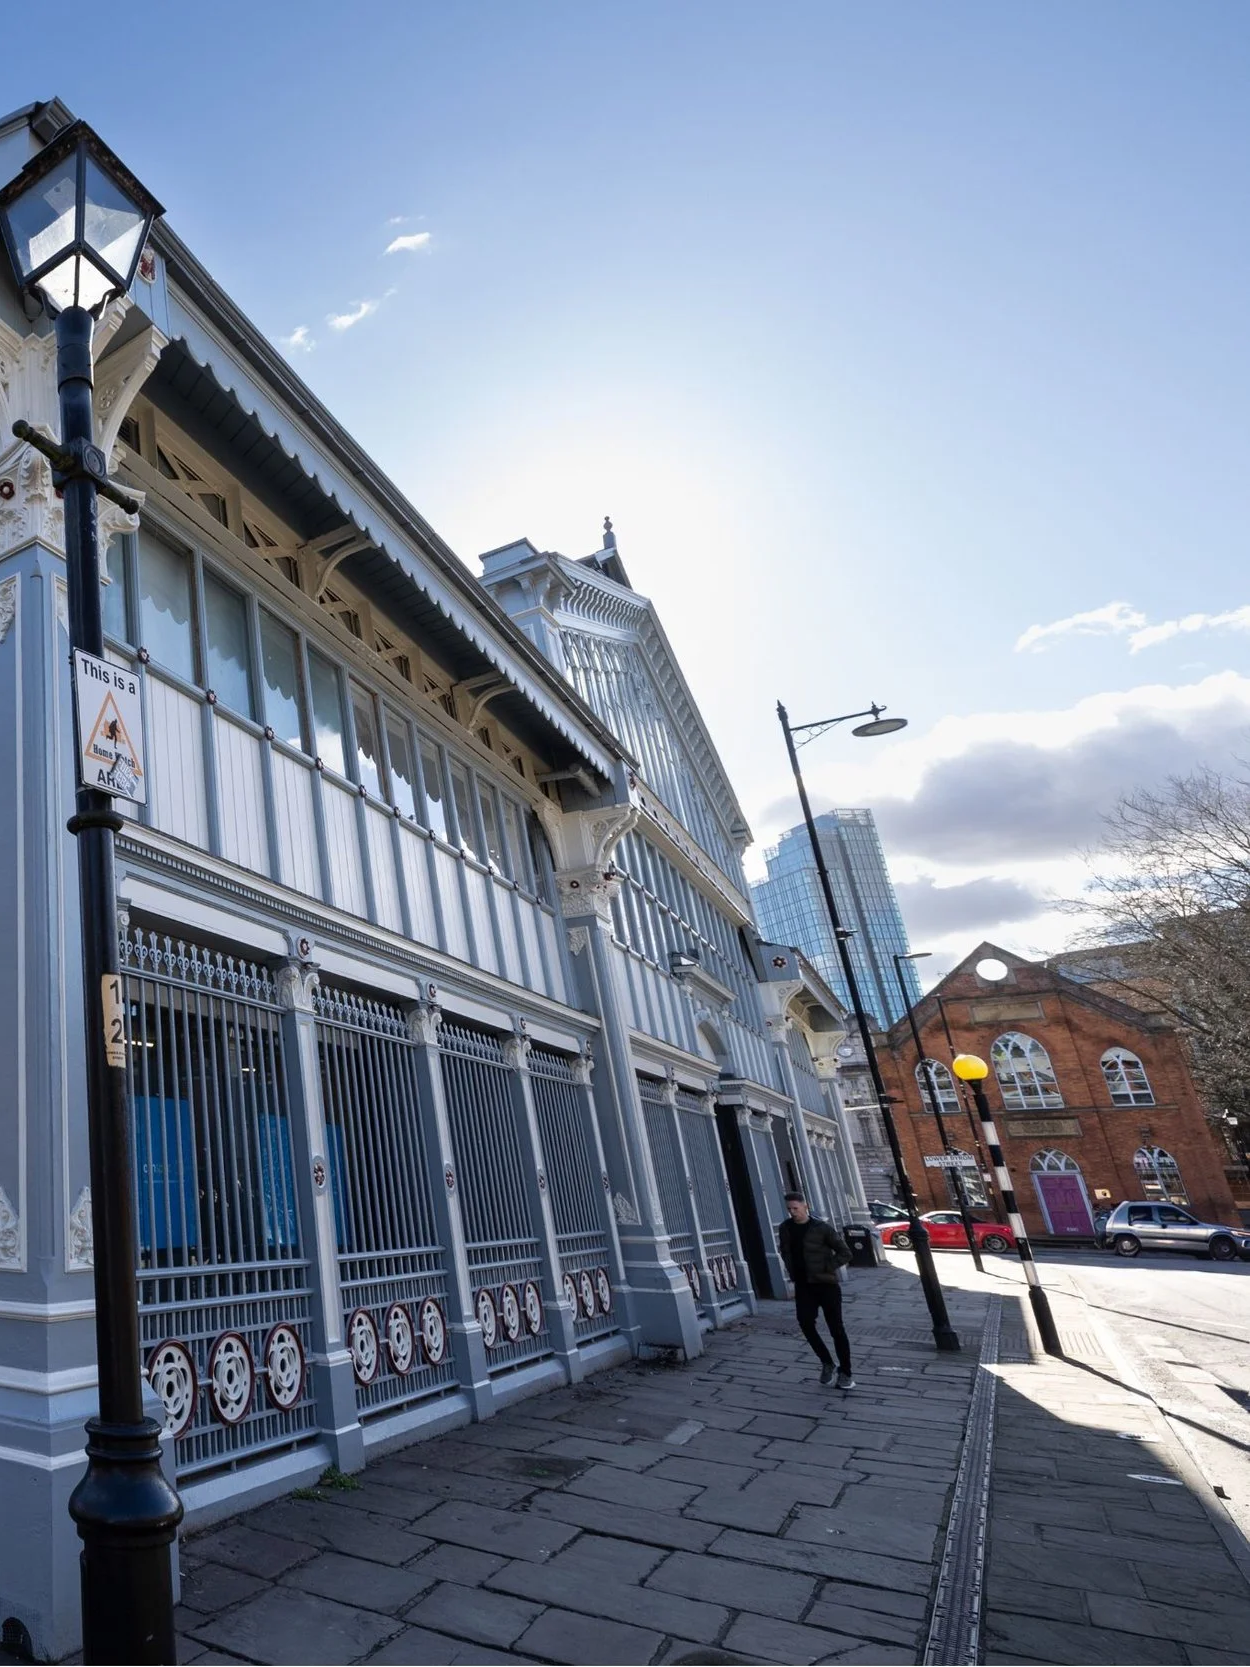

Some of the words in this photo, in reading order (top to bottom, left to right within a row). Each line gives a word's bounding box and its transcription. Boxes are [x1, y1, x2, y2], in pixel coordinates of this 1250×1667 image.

[81, 658, 110, 684] This
[113, 672, 125, 690] is
[128, 683, 136, 695] a
[93, 744, 113, 760] Home
[97, 768, 124, 791] AR
